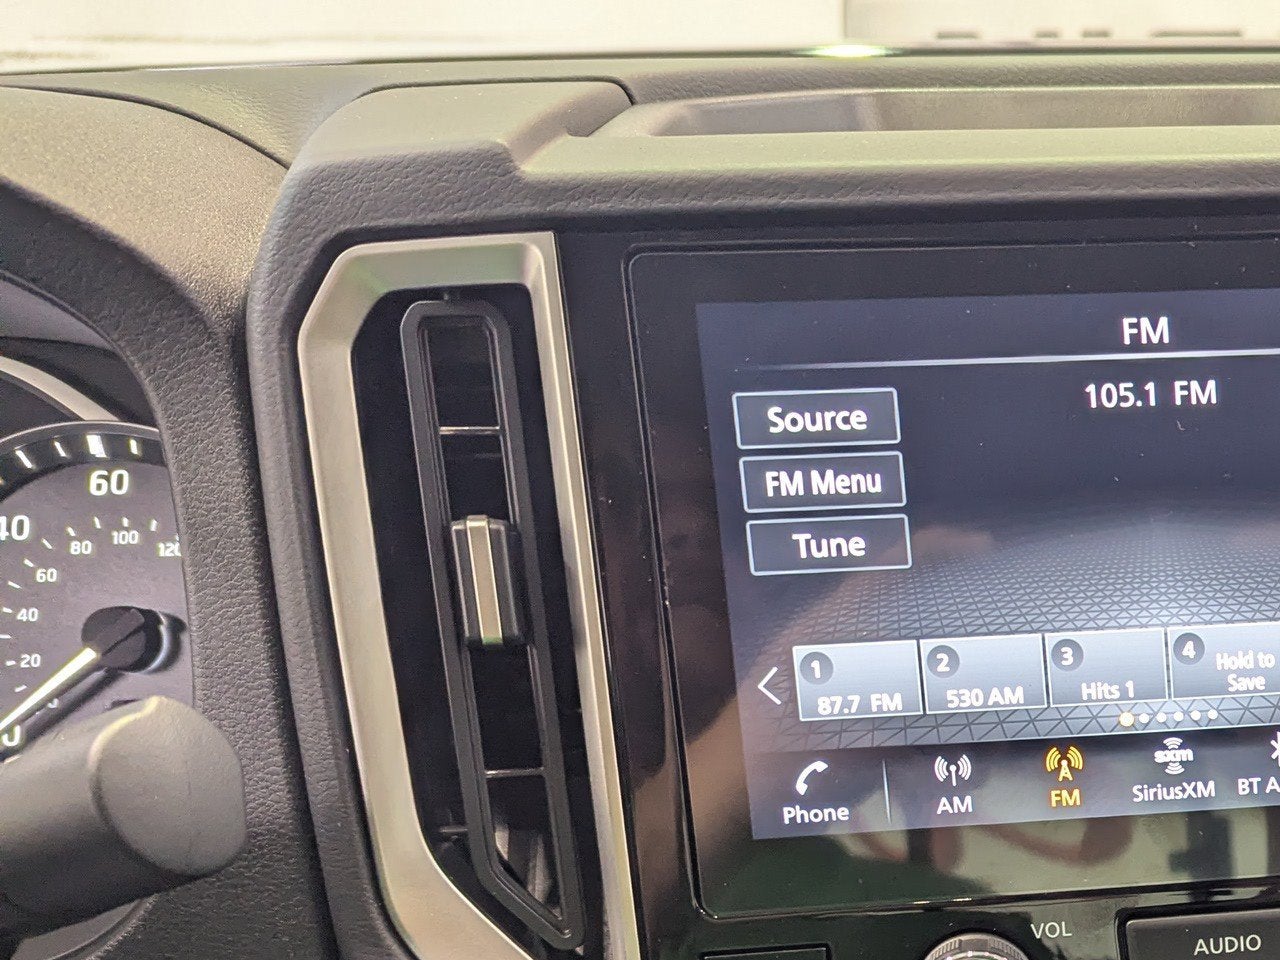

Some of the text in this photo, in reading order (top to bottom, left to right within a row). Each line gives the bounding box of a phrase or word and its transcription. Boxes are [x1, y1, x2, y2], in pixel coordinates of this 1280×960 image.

[1122, 317, 1169, 345] FM
[1085, 380, 1217, 408] 105.1 FM
[767, 407, 867, 433] Source
[89, 470, 129, 495] 60
[766, 470, 881, 497] FM Menu
[111, 530, 138, 545] 100
[792, 533, 865, 559] Tune
[70, 540, 92, 555] 80
[36, 568, 57, 583] 60
[16, 608, 38, 623] 40
[1061, 647, 1073, 665] 3
[1182, 641, 1195, 658] 4
[20, 654, 41, 668] 20
[810, 660, 822, 679] 1
[937, 654, 950, 672] 2
[1217, 652, 1275, 671] Hold to
[1081, 681, 1134, 701] Hits 1
[1227, 674, 1265, 692] Save
[817, 693, 902, 715] 87.7 FM
[946, 686, 1024, 708] 530 AM
[1132, 780, 1216, 802] SiriusXM
[1238, 778, 1261, 796] BT
[937, 796, 973, 814] AM
[1051, 789, 1081, 807] FM
[783, 805, 849, 824] Phone
[1030, 922, 1071, 939] VOL
[1194, 935, 1261, 956] AUDIO
